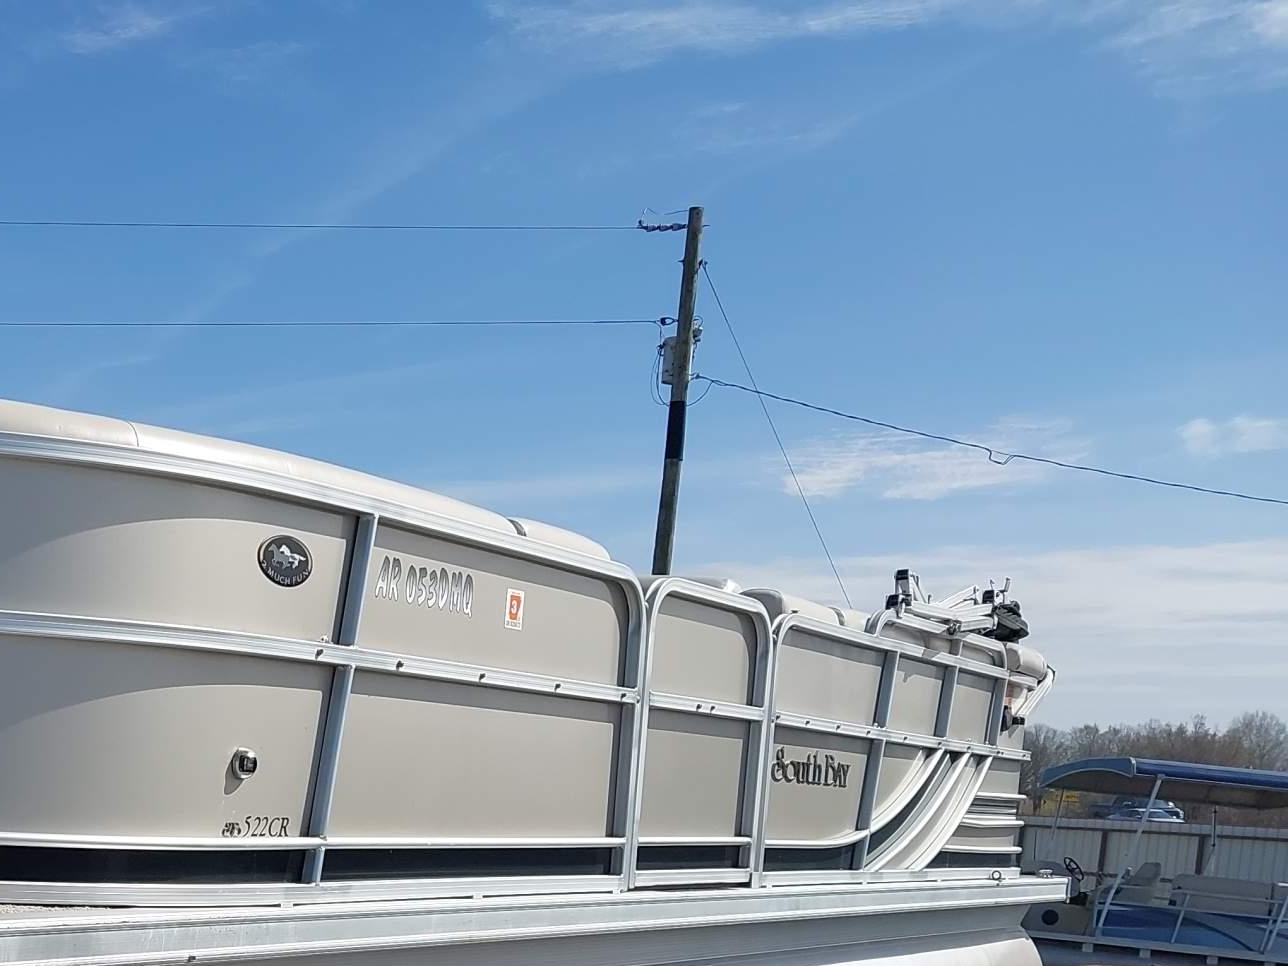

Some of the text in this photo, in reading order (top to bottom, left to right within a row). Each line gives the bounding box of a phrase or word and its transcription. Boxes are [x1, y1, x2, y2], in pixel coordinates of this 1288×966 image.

[267, 566, 291, 585] MUCH
[292, 568, 310, 585] FUN
[375, 555, 402, 601] AR
[510, 599, 518, 615] 3
[771, 746, 822, 786] South
